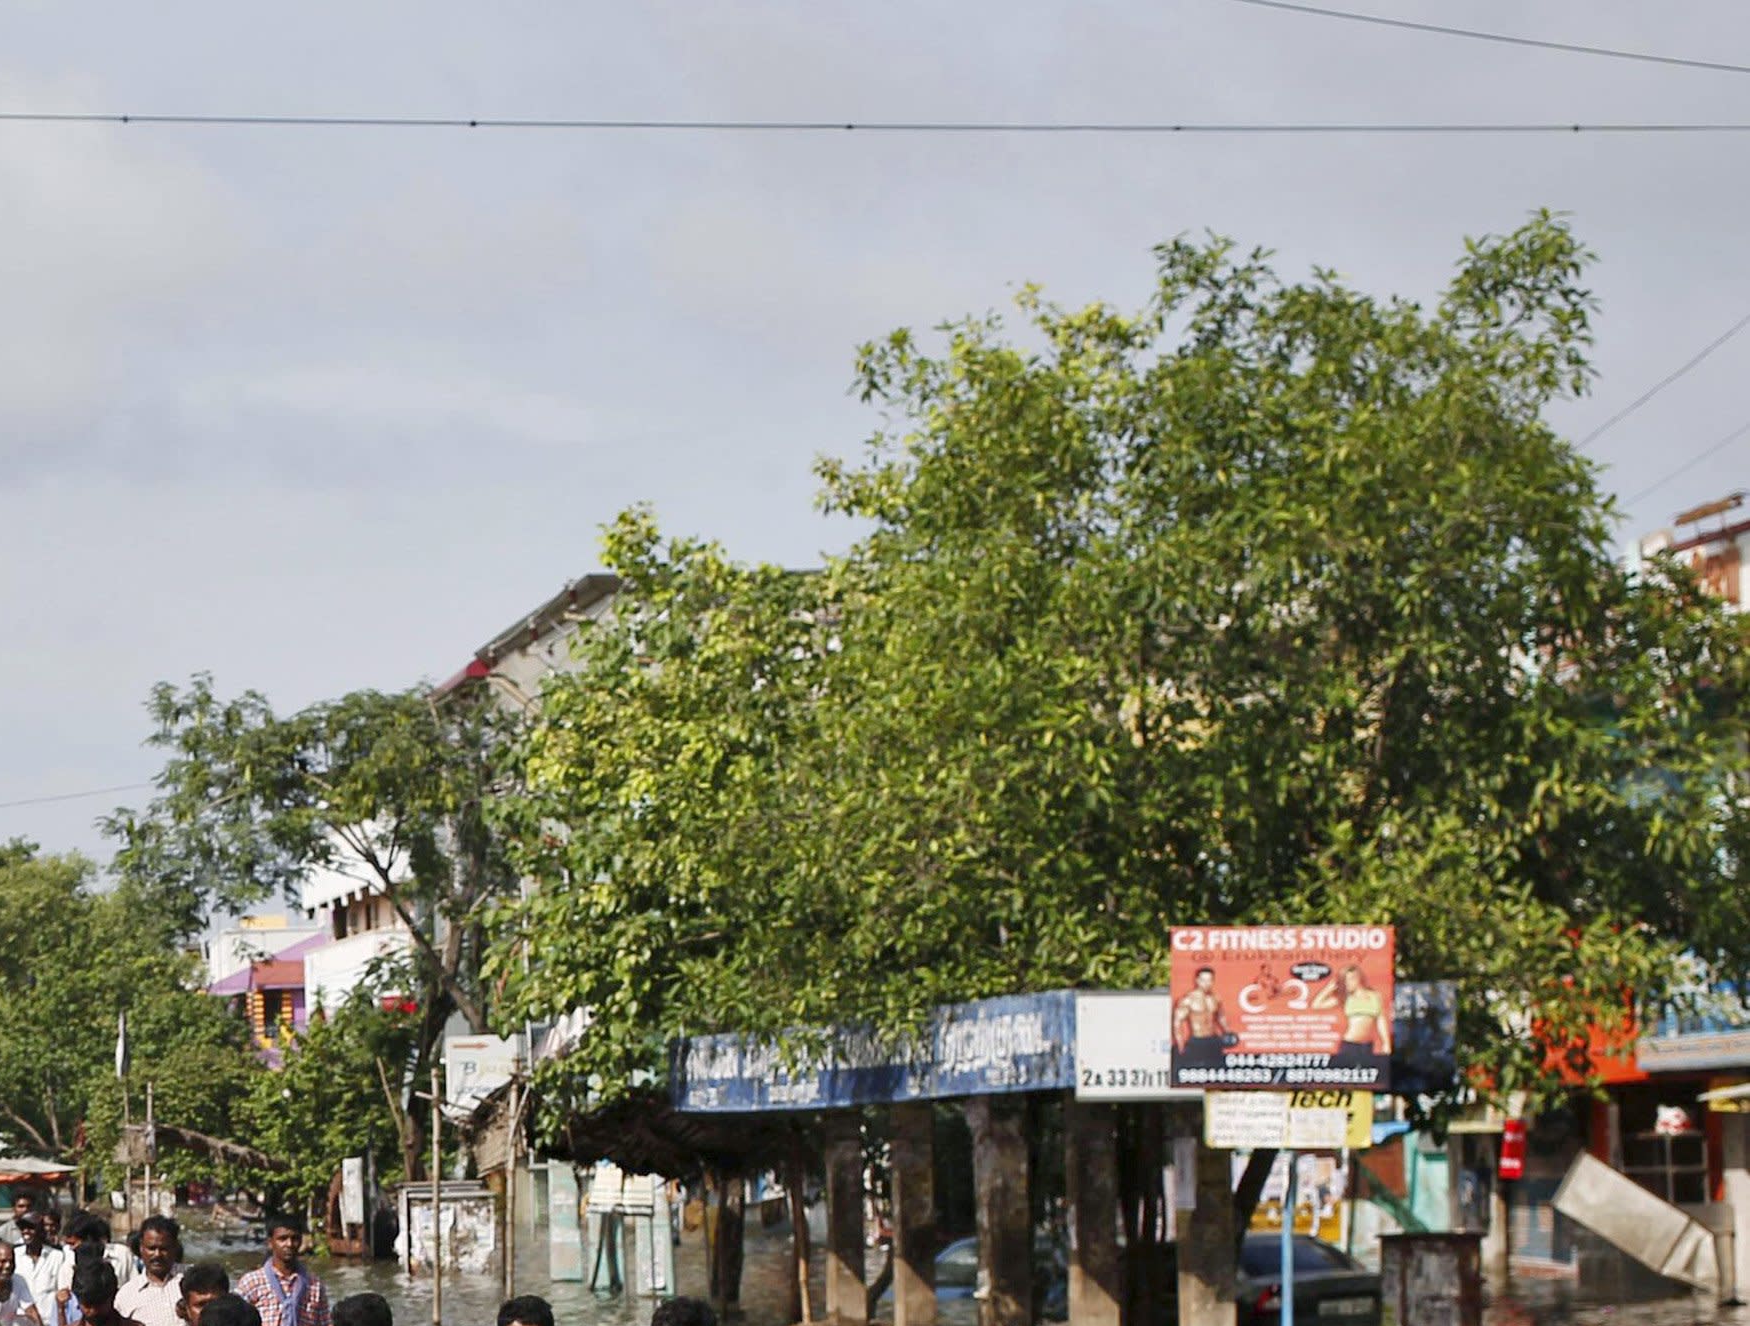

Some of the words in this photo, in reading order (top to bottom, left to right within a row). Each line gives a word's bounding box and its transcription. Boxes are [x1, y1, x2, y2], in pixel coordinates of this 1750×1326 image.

[1171, 930, 1204, 951] C2
[1207, 929, 1297, 950] FITNESS
[1300, 928, 1388, 949] STUDIO
[1107, 1069, 1127, 1087] 33
